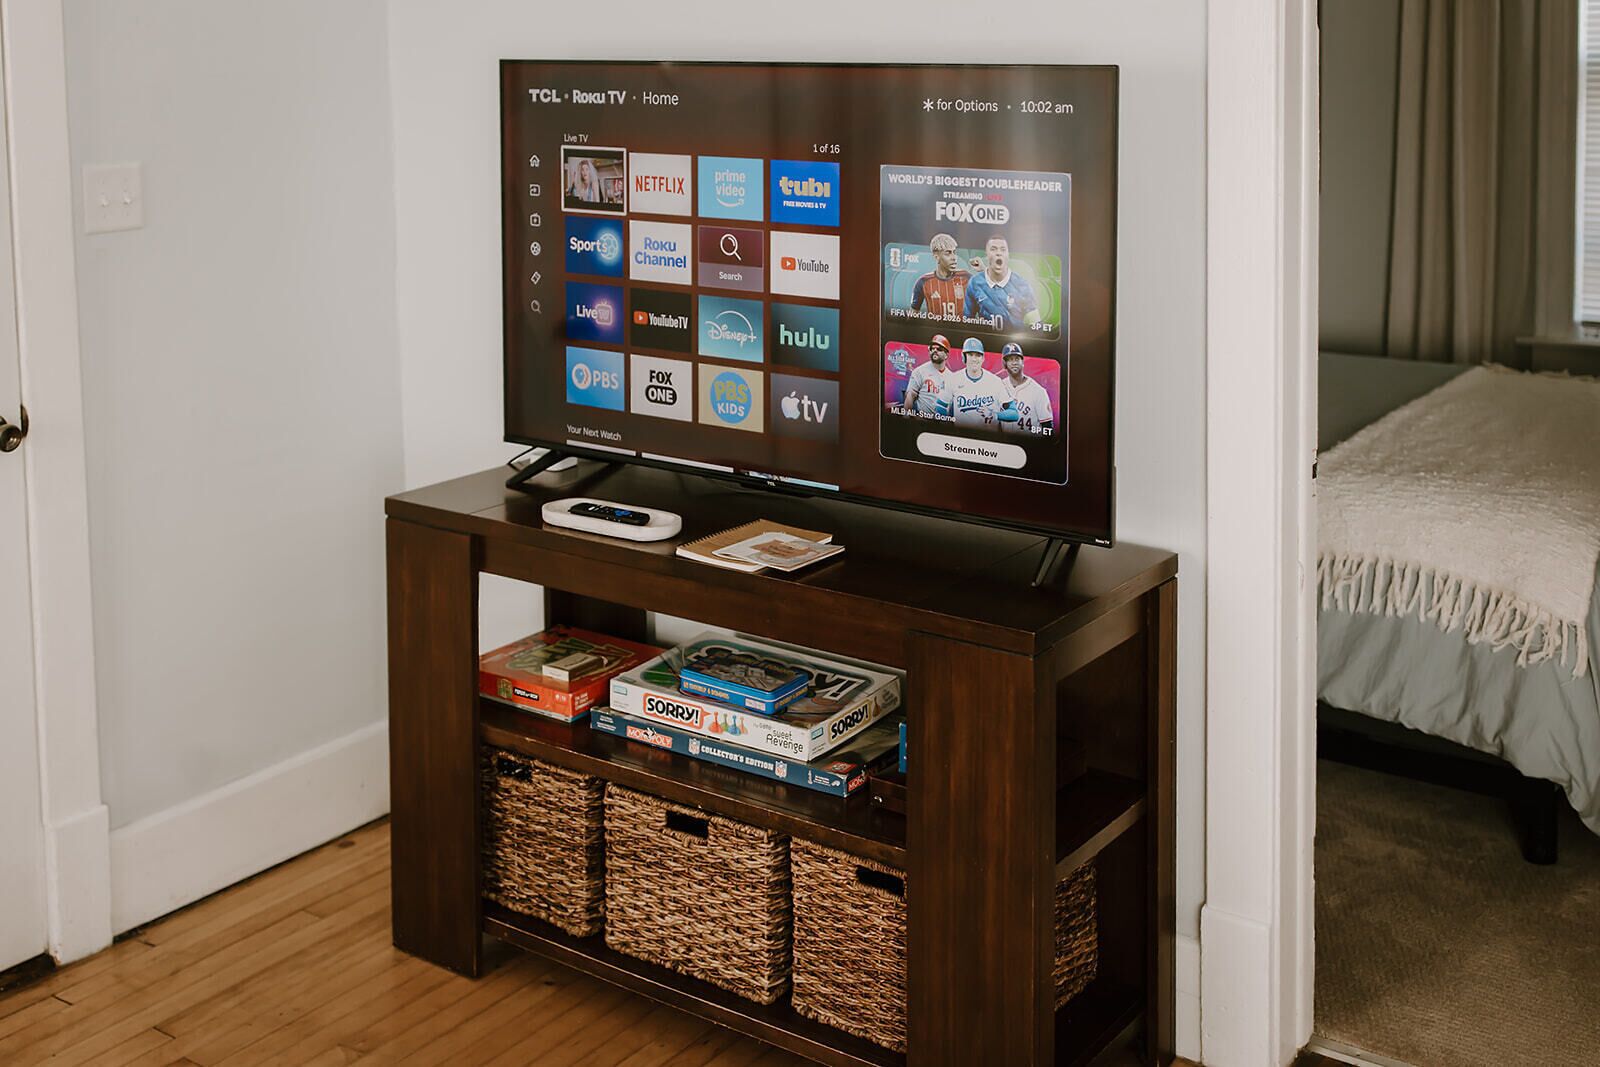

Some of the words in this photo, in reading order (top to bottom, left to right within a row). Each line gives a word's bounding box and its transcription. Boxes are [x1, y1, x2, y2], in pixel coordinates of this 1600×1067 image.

[529, 89, 561, 102] TCL
[608, 91, 626, 104] TV
[643, 91, 679, 105] Home
[936, 99, 952, 111] for
[955, 99, 998, 113] Options
[1020, 101, 1052, 113] 10:02
[1055, 103, 1074, 114] am
[563, 134, 578, 142] Live
[579, 134, 588, 143] TV
[813, 144, 818, 153] 1
[819, 144, 829, 153] of
[830, 144, 840, 154] 16
[714, 169, 746, 183] prime
[888, 173, 933, 185] WORLD'S
[935, 175, 977, 188] BIGGEST
[979, 178, 1062, 192] DOUBLEHEADER
[635, 175, 685, 195] NETFLIX
[715, 183, 746, 197] video
[779, 176, 831, 198] tubi
[943, 191, 983, 201] STREAMING
[935, 201, 974, 223] FOX
[976, 207, 1005, 221] ONE
[570, 236, 608, 253] Sports
[634, 251, 687, 268] Channel
[797, 258, 829, 273] YouTube
[719, 271, 743, 281] Search
[576, 304, 598, 319] Live
[890, 308, 905, 318] FIFA
[906, 310, 927, 321] World
[928, 313, 942, 324] Cup
[1043, 323, 1053, 332] ET
[780, 323, 830, 350] hulu
[592, 370, 619, 390] PBS
[649, 369, 673, 386] FOX
[647, 387, 674, 403] ONE
[713, 380, 748, 403] PBS
[717, 402, 745, 417] KIDS
[801, 394, 828, 423] tv
[956, 394, 995, 409] Dodgers
[890, 406, 906, 415] MLB
[935, 412, 957, 422] Game
[1017, 416, 1033, 431] 44
[1043, 427, 1053, 436] ET
[566, 424, 582, 435] Your
[583, 427, 600, 438] Next
[600, 429, 622, 441] Watch
[944, 442, 977, 455] Stream
[977, 448, 998, 458] Now
[647, 697, 700, 724] SORRY!
[830, 704, 869, 740] SORRY!
[766, 733, 804, 754] Revenge
[701, 745, 744, 763] COLLECTOR'S
[745, 756, 774, 771] EDITION
